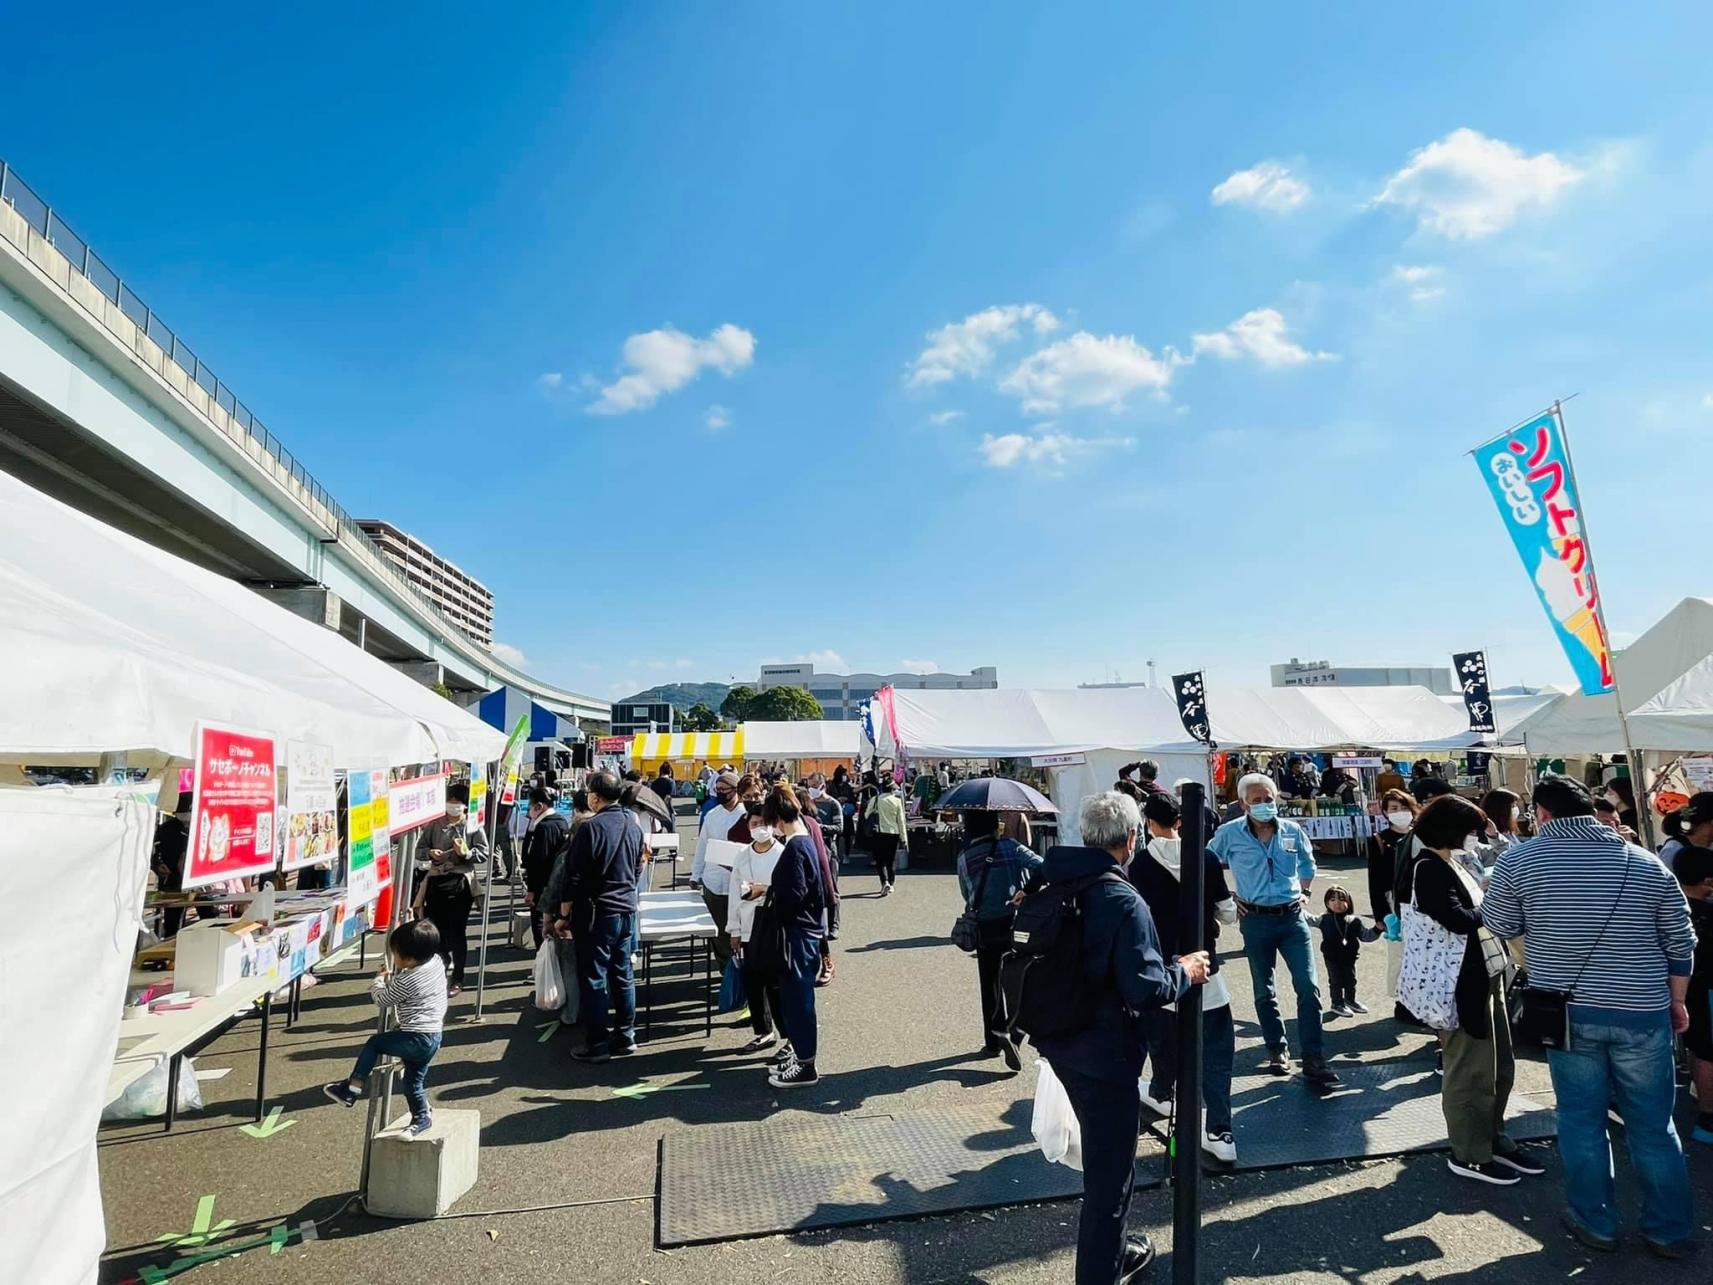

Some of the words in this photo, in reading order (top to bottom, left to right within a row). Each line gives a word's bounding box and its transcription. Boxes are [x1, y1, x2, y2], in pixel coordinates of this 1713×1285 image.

[1496, 459, 1536, 520] おいしい
[209, 758, 271, 776] サセボーノチャンネル
